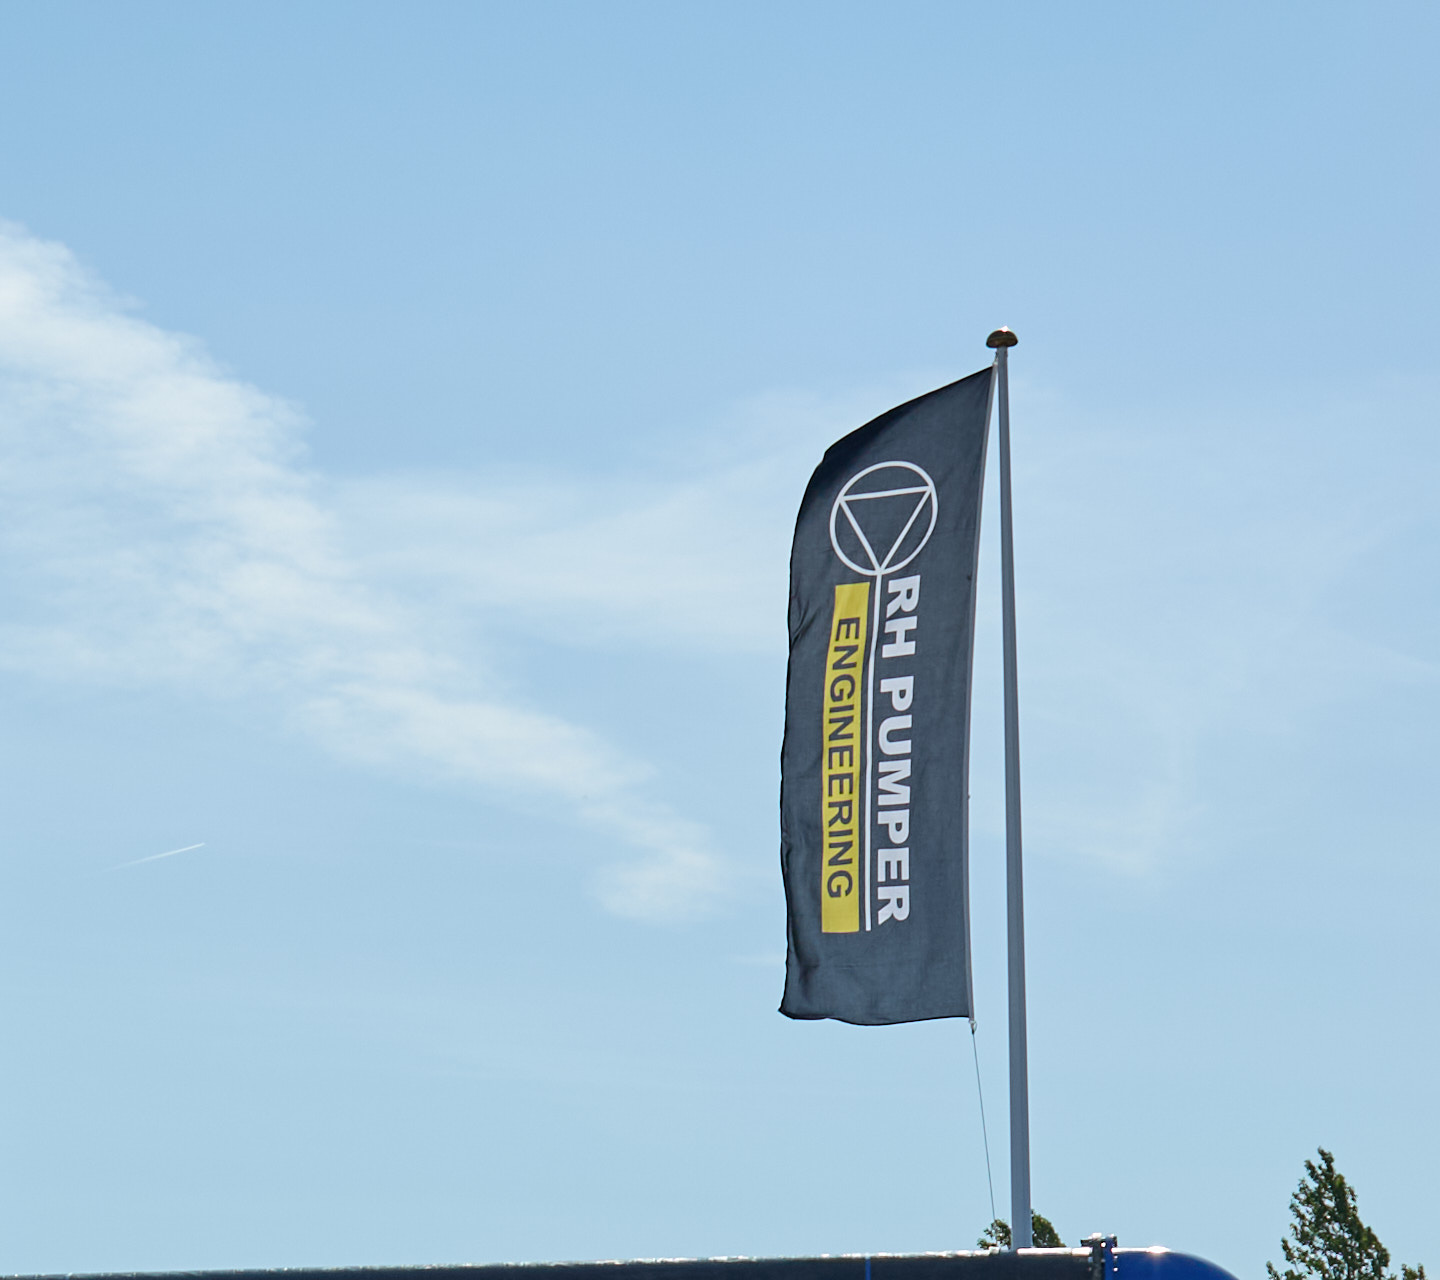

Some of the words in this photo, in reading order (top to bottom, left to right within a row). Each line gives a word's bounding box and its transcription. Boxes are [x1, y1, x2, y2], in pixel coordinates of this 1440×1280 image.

[882, 575, 920, 658] RH
[826, 616, 861, 899] ENGINEERING
[876, 675, 915, 926] PUMPER
